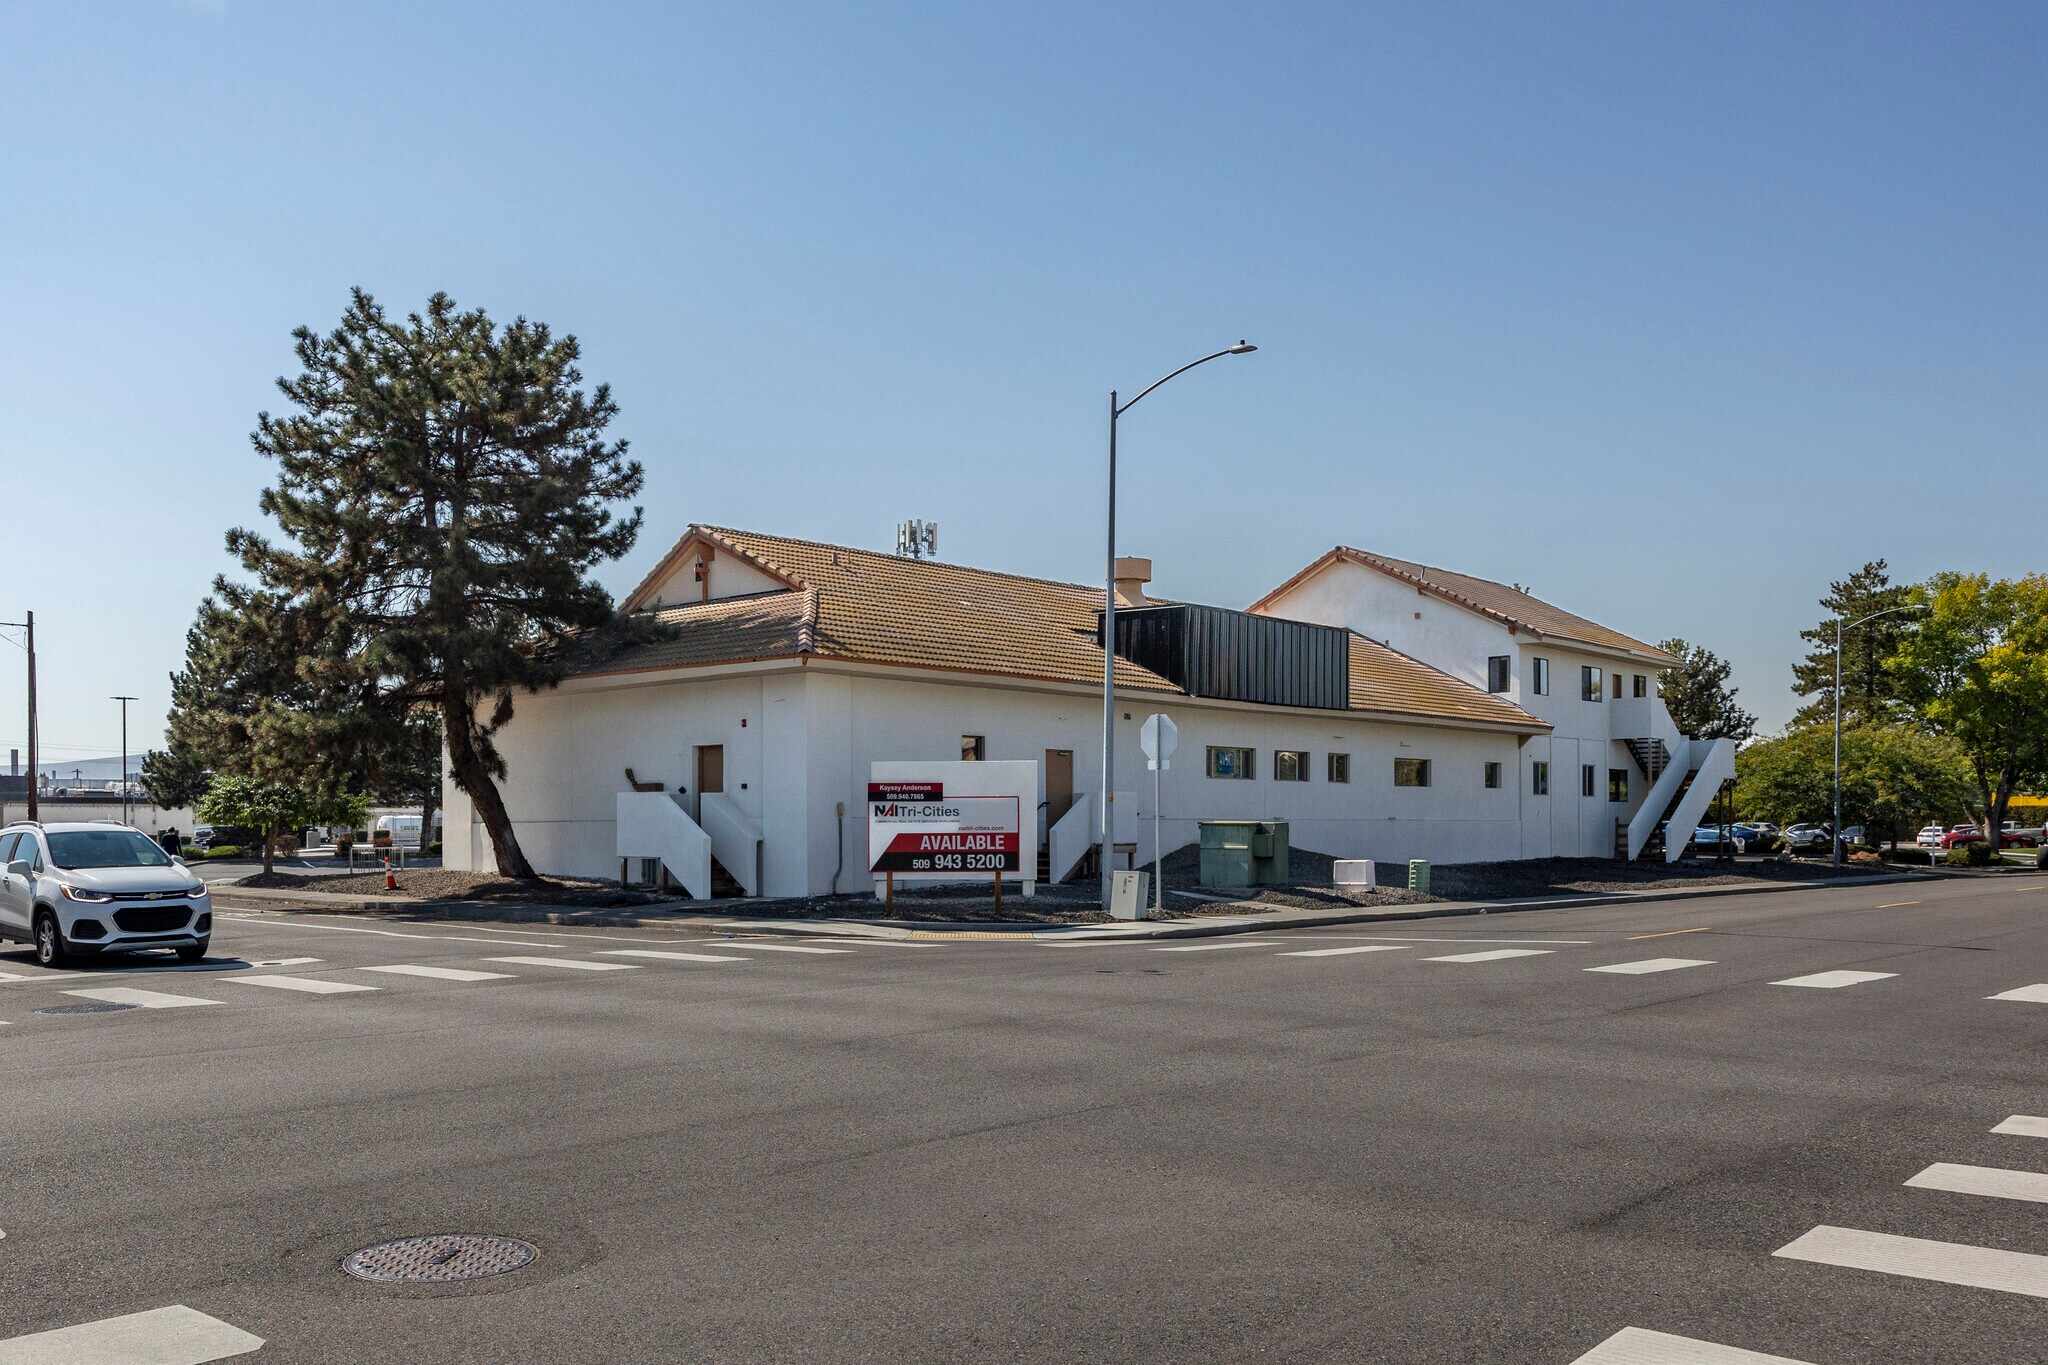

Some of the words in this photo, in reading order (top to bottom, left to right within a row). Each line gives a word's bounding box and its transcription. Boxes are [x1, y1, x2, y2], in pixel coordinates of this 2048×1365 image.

[899, 806, 960, 817] Tri-Cities
[920, 835, 1004, 850] AVAILABLE
[912, 860, 930, 869] 509
[934, 854, 962, 868] 943
[966, 854, 1004, 868] 5200
